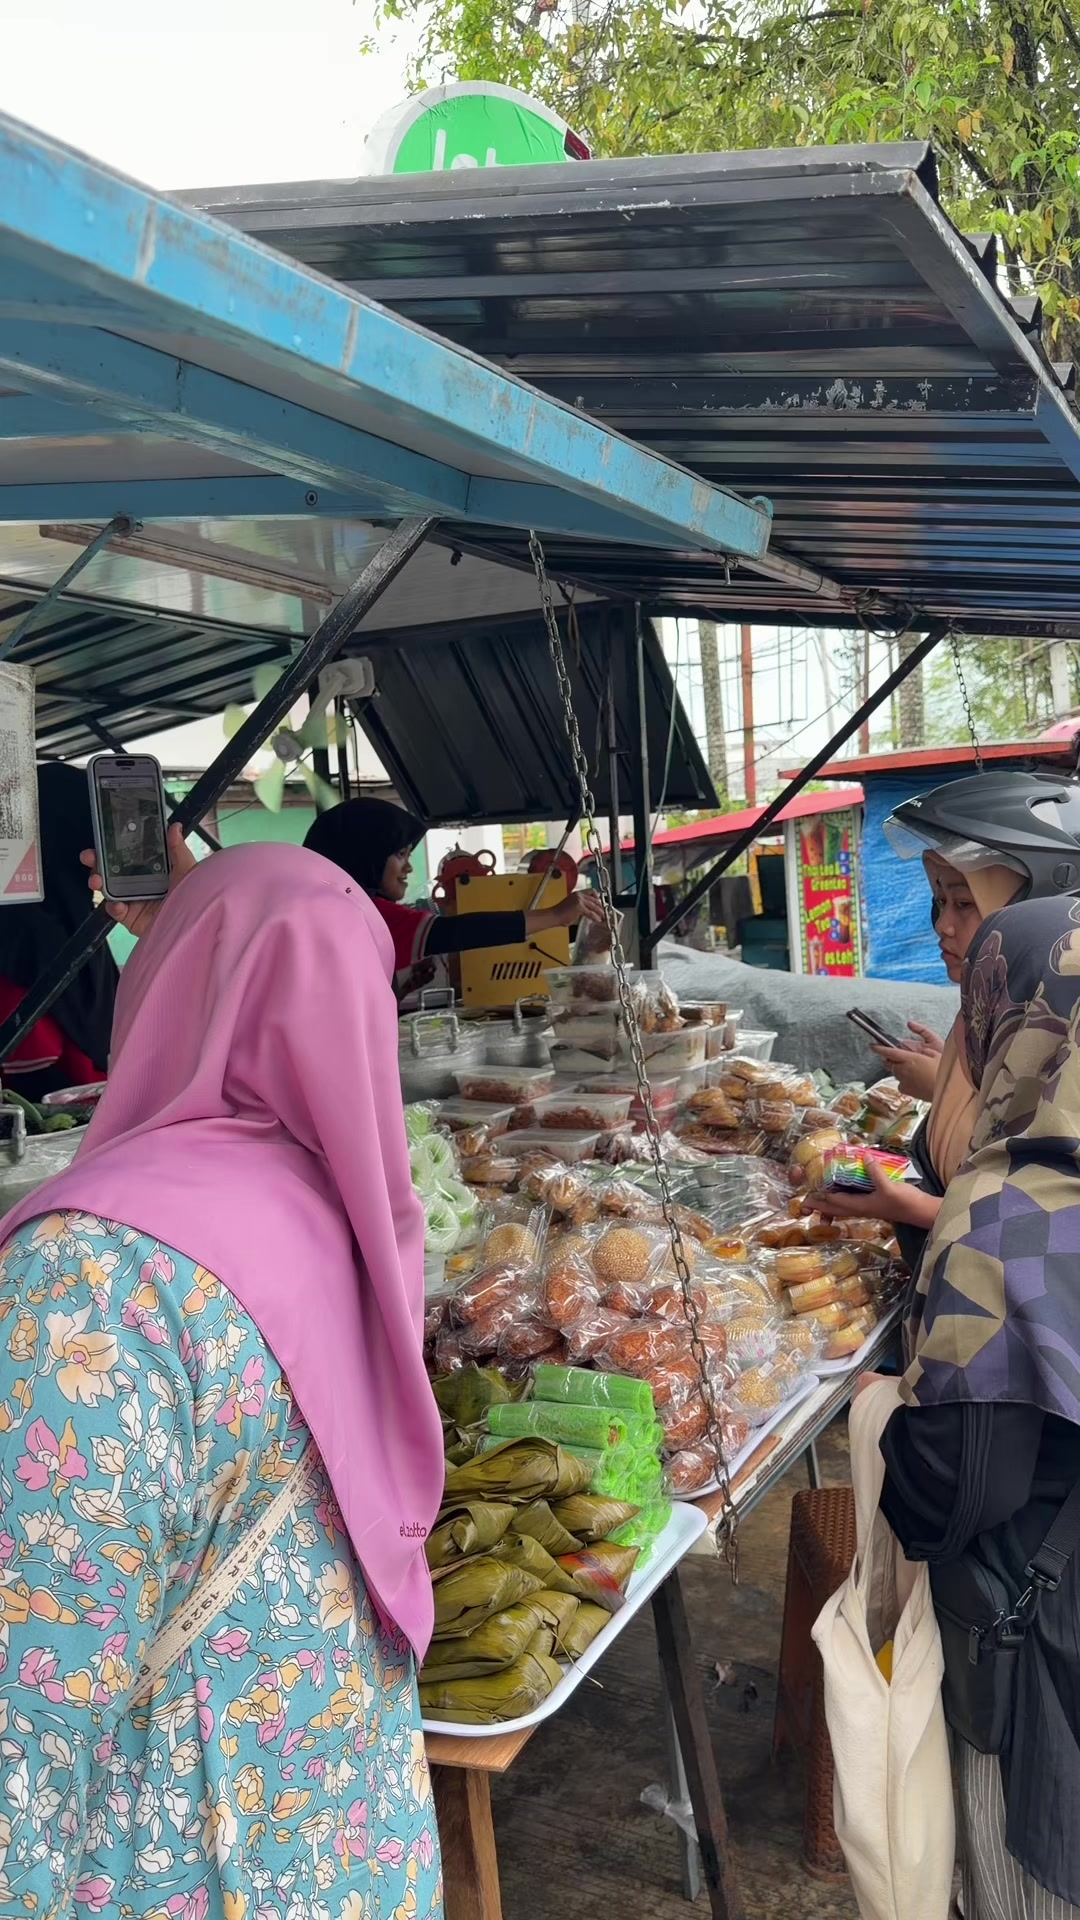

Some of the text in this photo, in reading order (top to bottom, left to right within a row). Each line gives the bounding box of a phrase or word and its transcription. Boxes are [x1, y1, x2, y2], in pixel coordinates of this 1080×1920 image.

[804, 899, 832, 923] Lemon
[815, 917, 831, 934] Tea
[228, 1529, 267, 1579] BEAR
[181, 1590, 220, 1632] 1929
